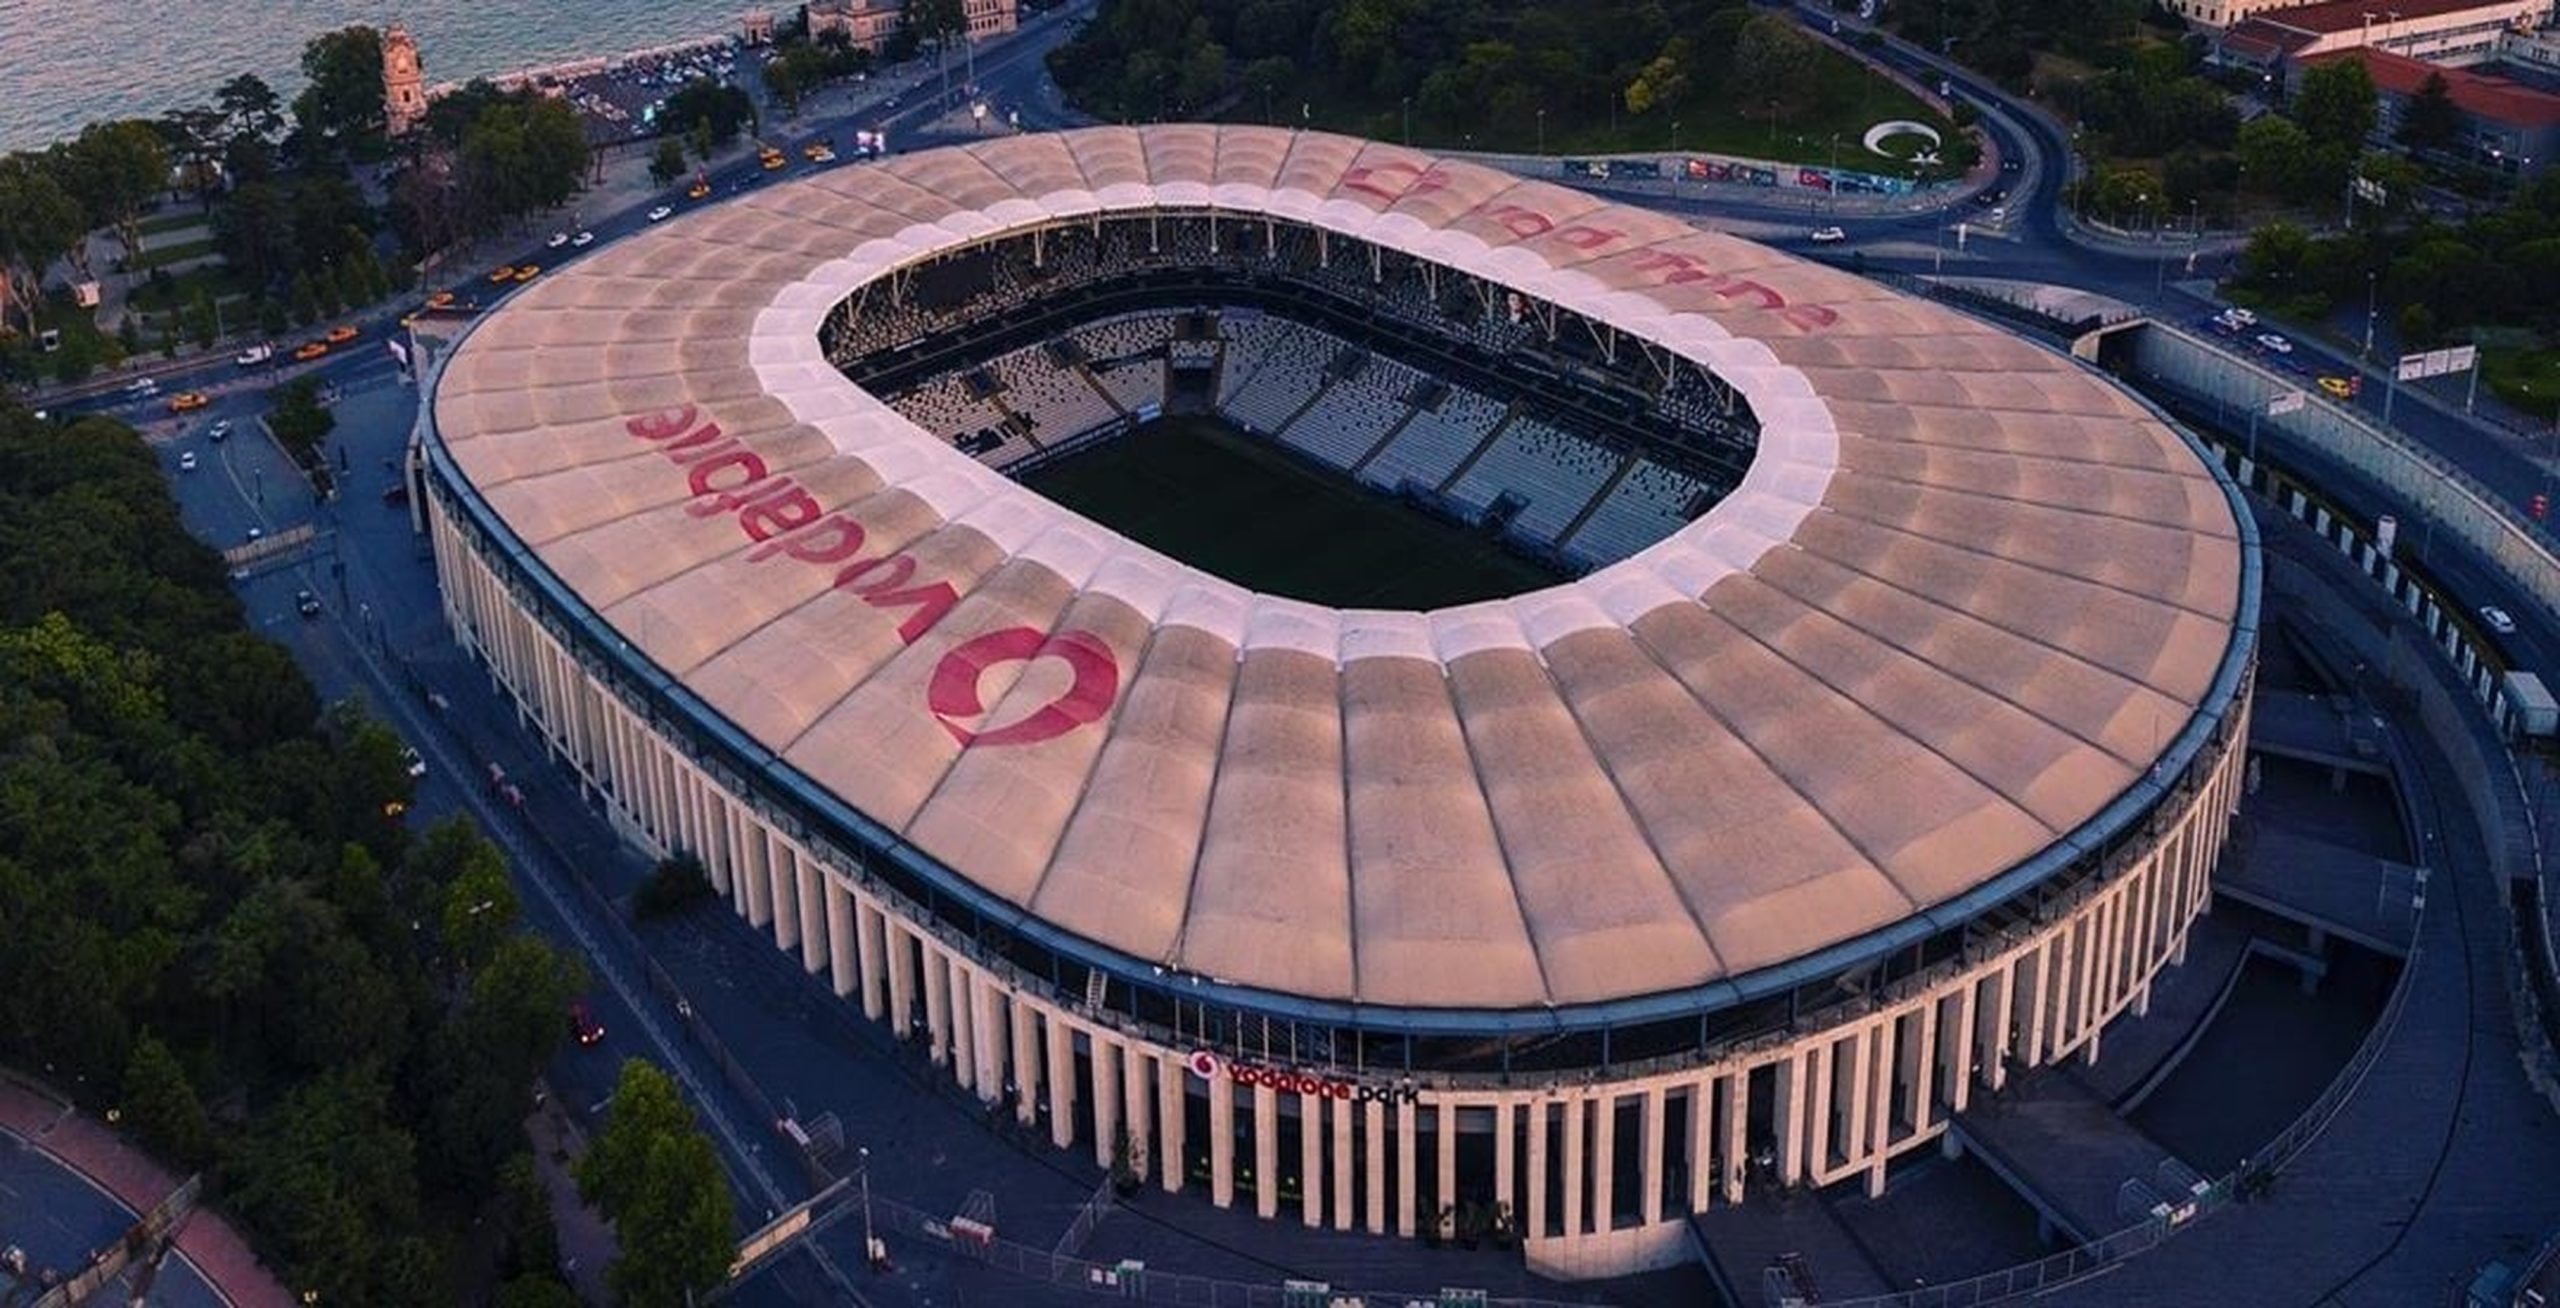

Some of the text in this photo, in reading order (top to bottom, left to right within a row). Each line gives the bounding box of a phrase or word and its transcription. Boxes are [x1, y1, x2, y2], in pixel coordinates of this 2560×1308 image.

[1473, 204, 1838, 333] odane
[1228, 1063, 1418, 1104] vodafone park
